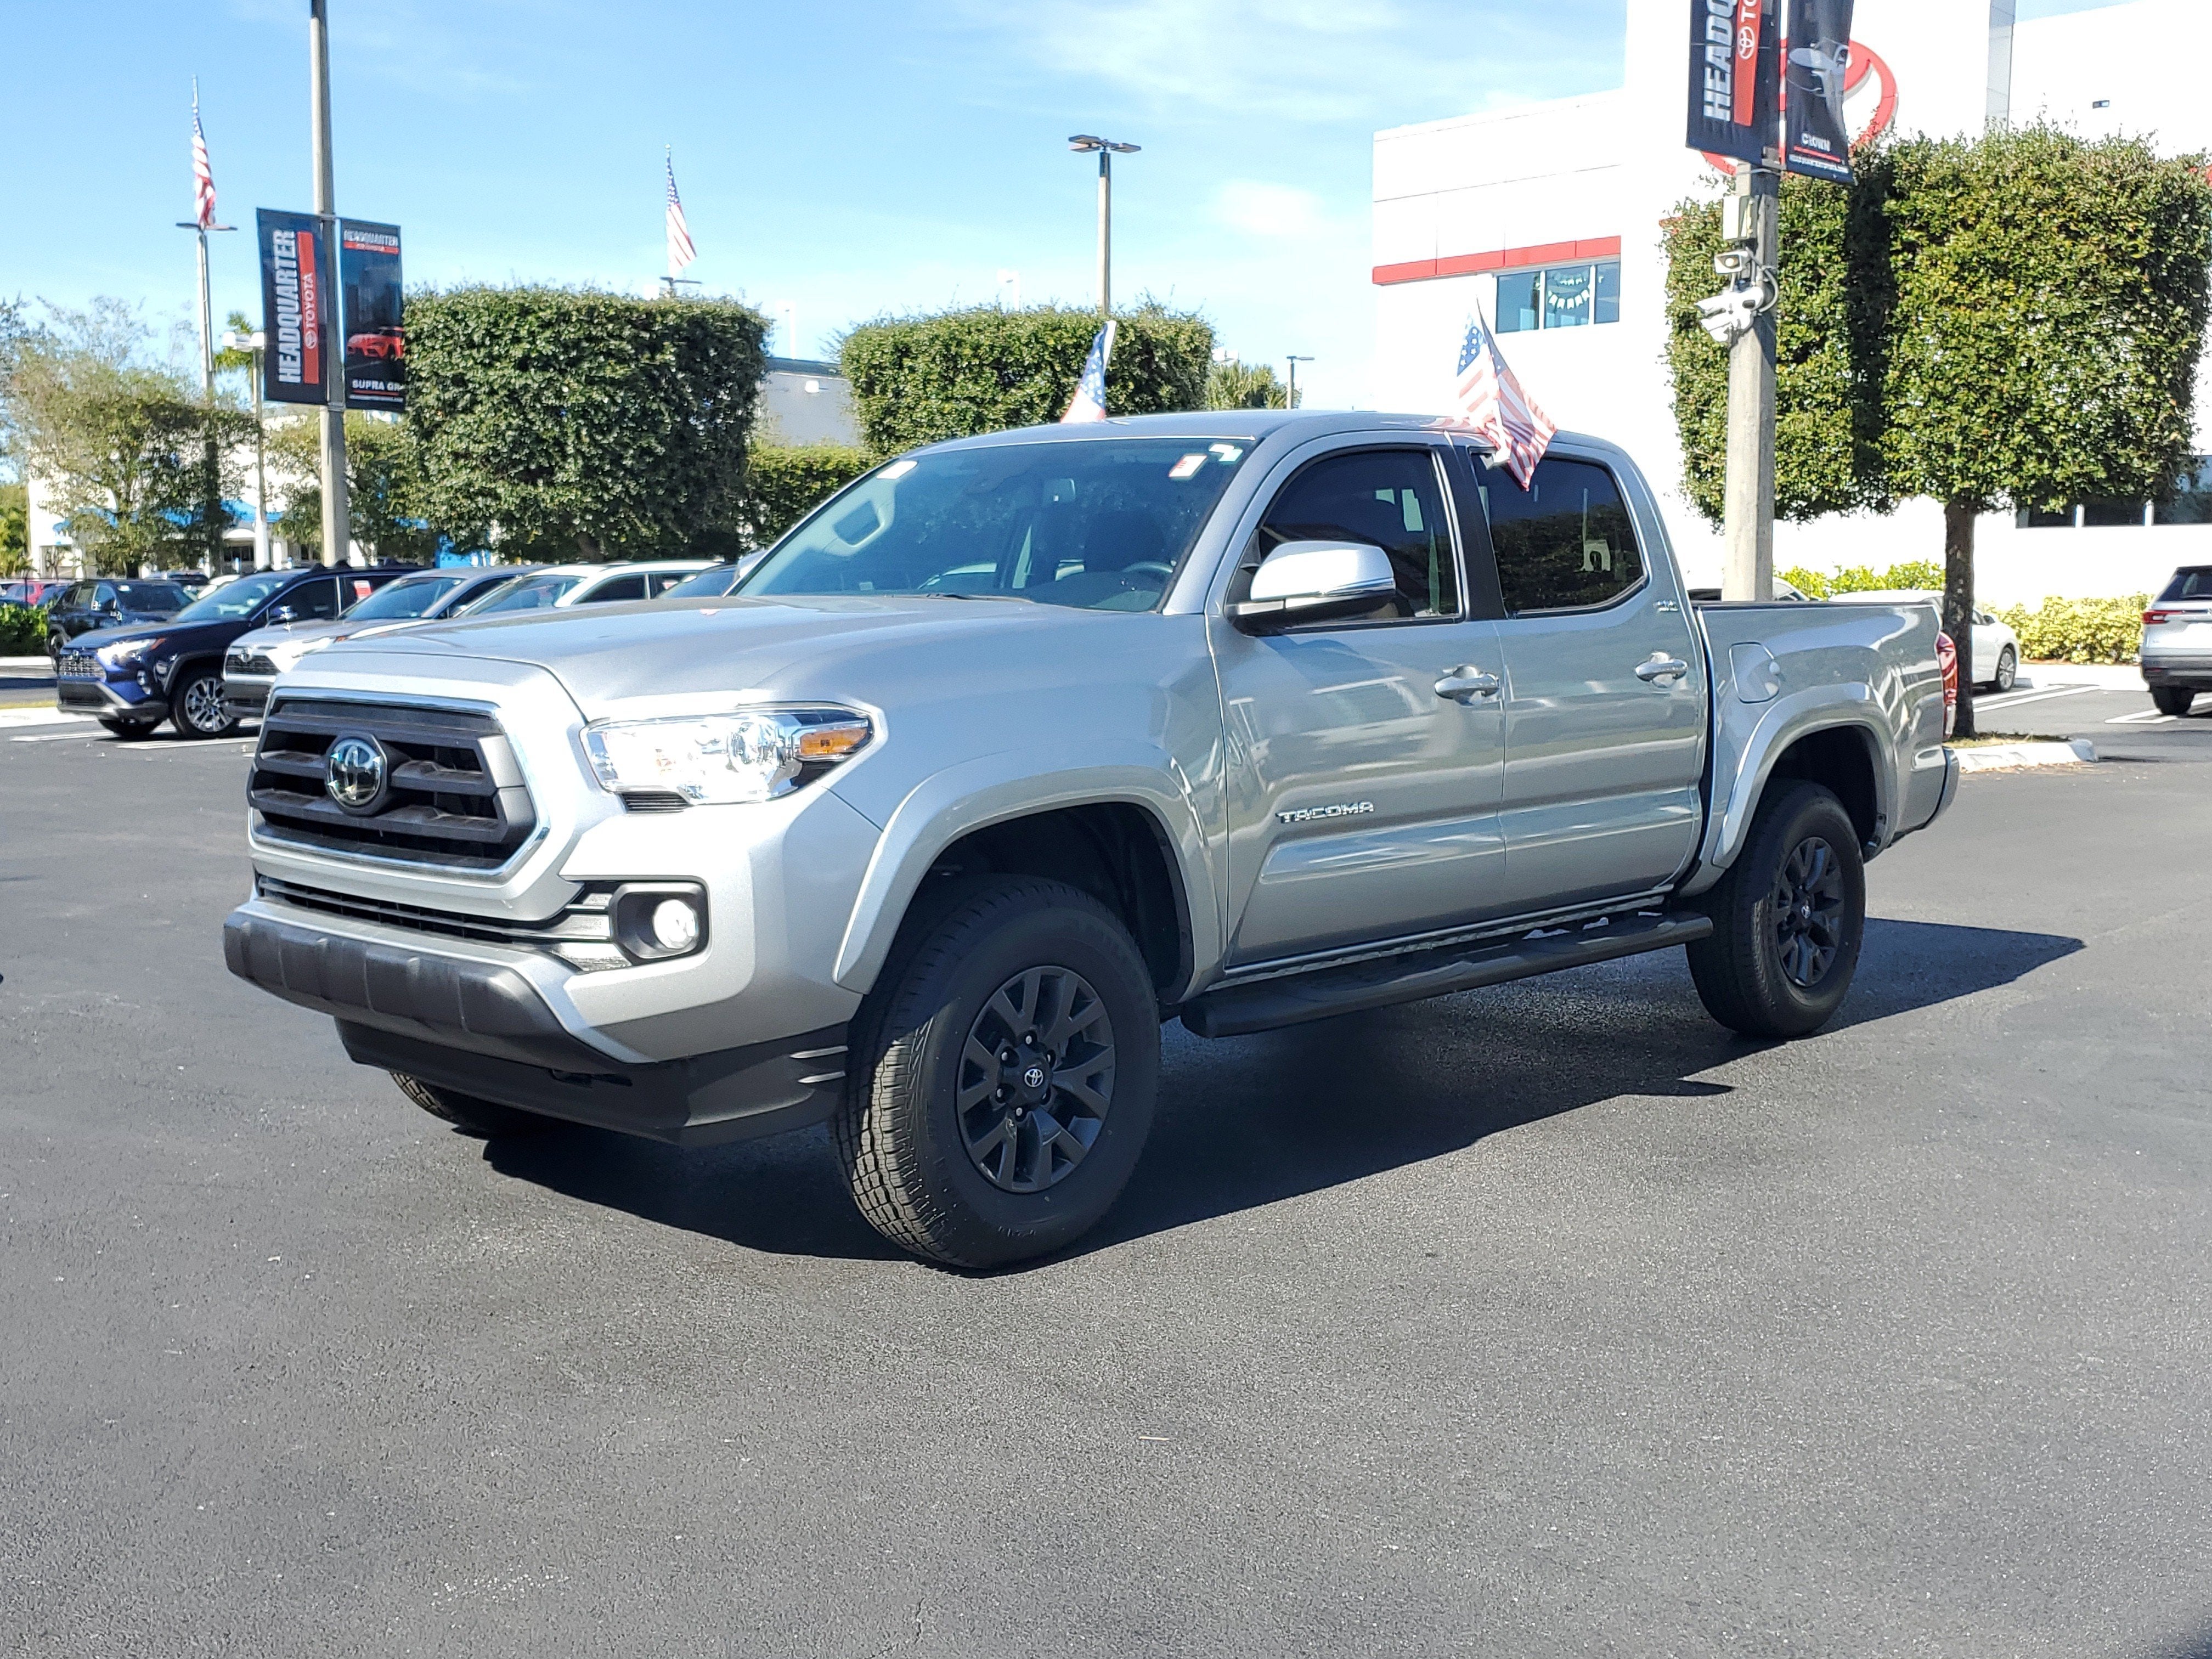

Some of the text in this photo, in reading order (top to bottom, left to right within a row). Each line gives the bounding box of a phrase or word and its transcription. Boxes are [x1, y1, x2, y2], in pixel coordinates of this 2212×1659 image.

[273, 229, 302, 383] HEADQUARTER
[303, 272, 315, 328] TOYOTA
[352, 379, 385, 390] SUPRA
[1276, 800, 1374, 823] TACOMA
